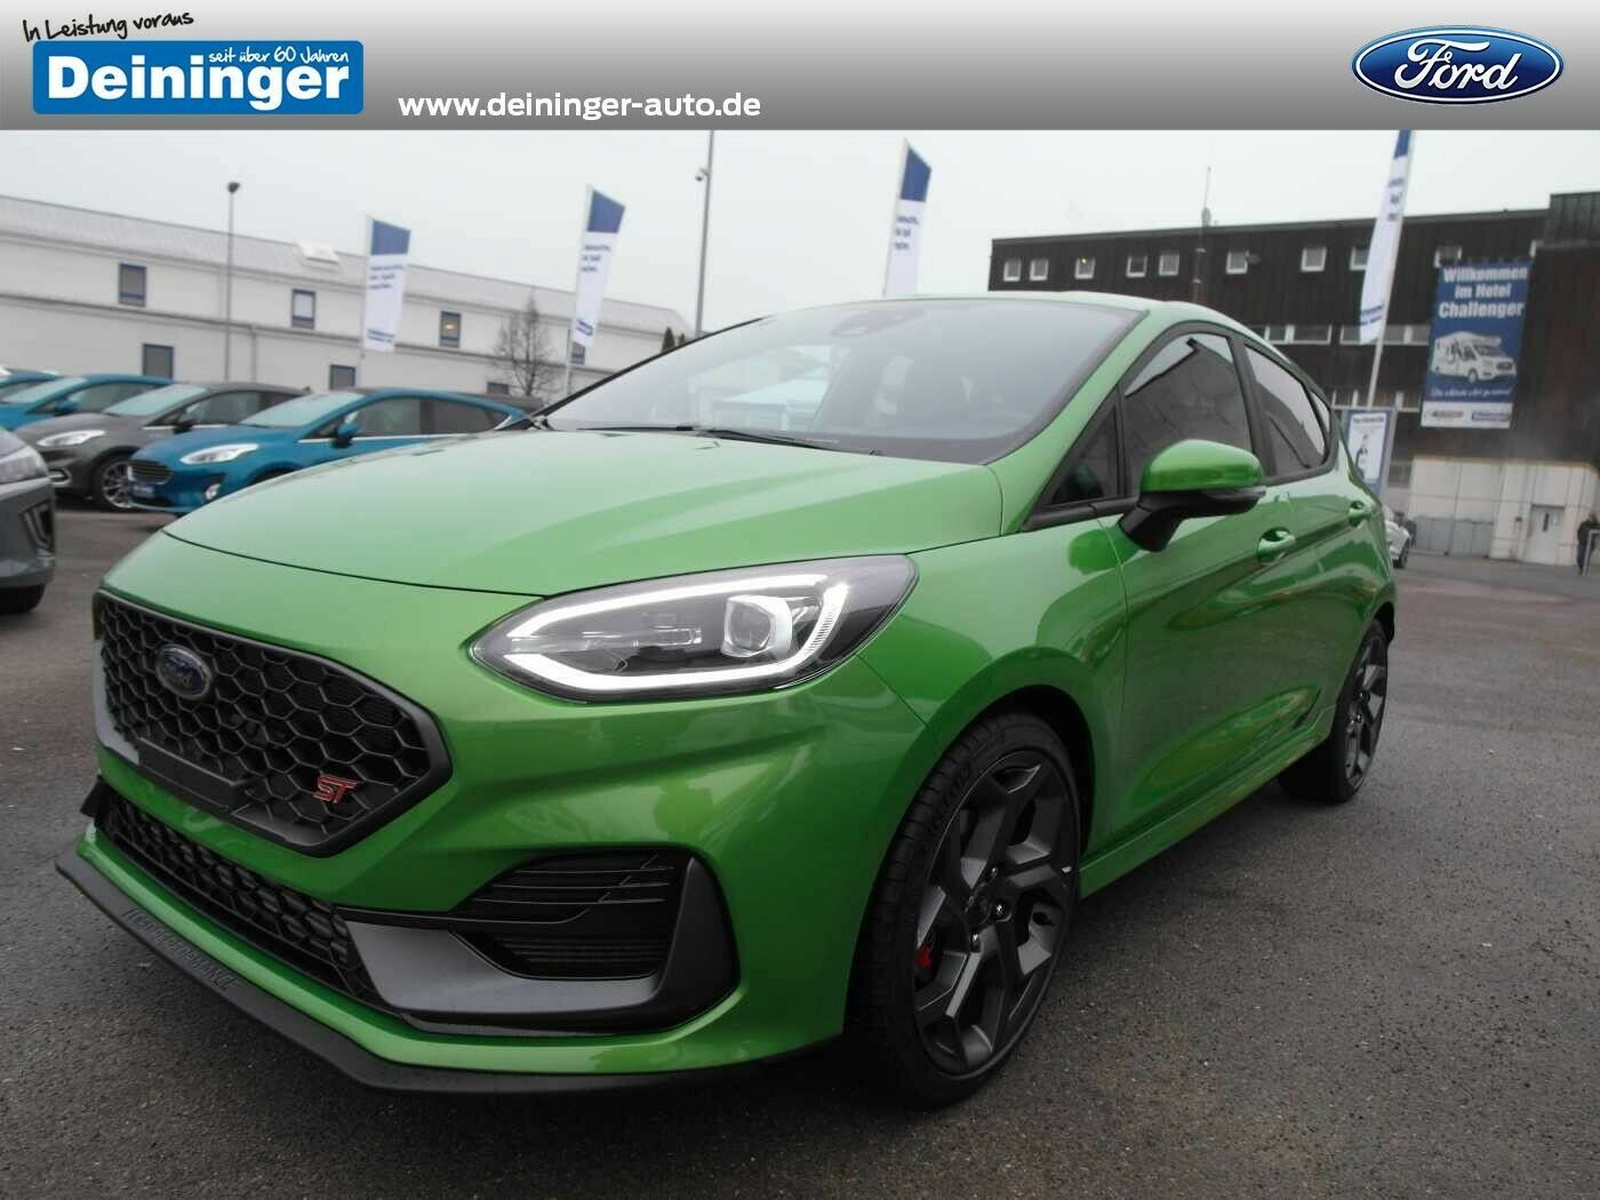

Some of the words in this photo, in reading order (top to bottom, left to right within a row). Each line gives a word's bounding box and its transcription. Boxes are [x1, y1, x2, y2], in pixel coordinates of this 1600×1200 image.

[1443, 267, 1528, 282] Willkommen
[1454, 283, 1472, 298] im
[1475, 282, 1511, 298] Hotel
[1438, 300, 1526, 318] Challenger
[312, 773, 359, 805] ST
